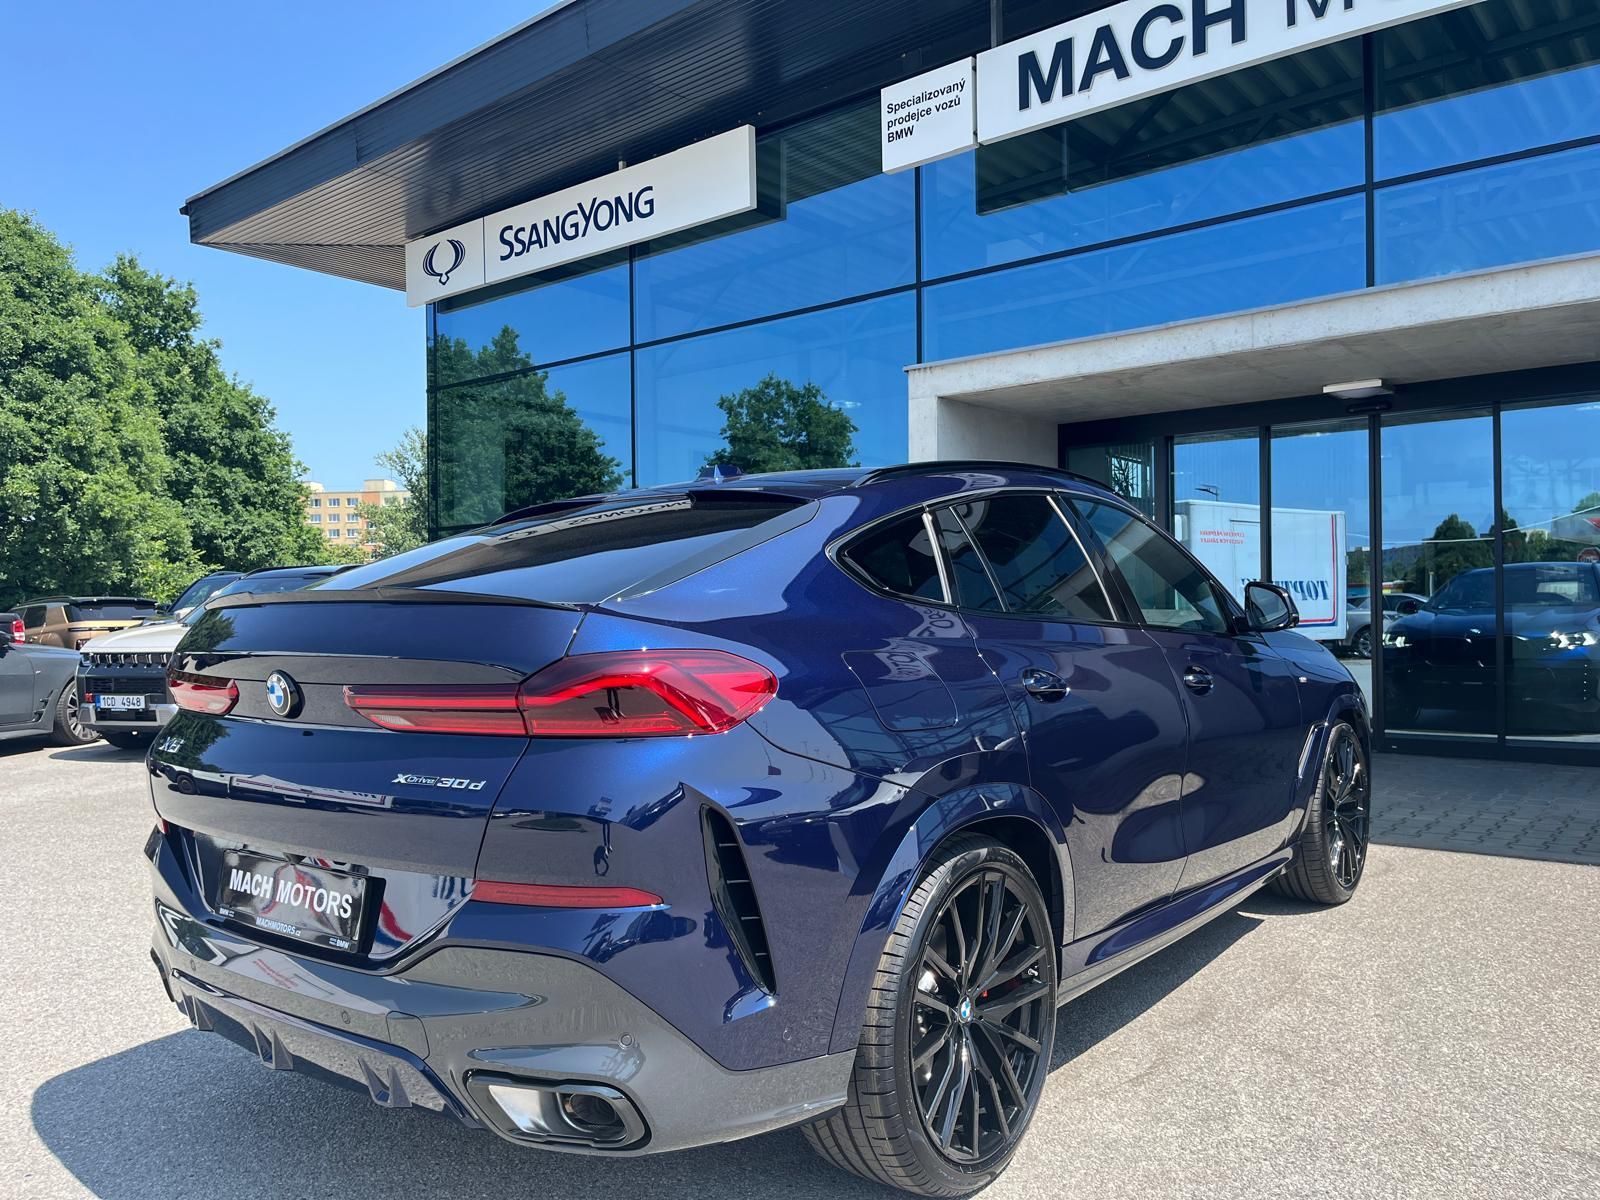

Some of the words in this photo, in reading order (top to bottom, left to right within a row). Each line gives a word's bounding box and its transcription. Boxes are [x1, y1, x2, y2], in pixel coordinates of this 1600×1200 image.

[1018, 0, 1247, 112] MACH
[886, 77, 966, 115] Specializovaný
[887, 108, 932, 131] prodejce
[935, 95, 961, 112] vozů
[887, 125, 915, 144] BMW
[498, 185, 655, 262] SSANGYONG
[102, 696, 116, 708] 1CD
[121, 696, 142, 708] 4948
[229, 868, 274, 899] MACH
[275, 879, 353, 919] MOTORS
